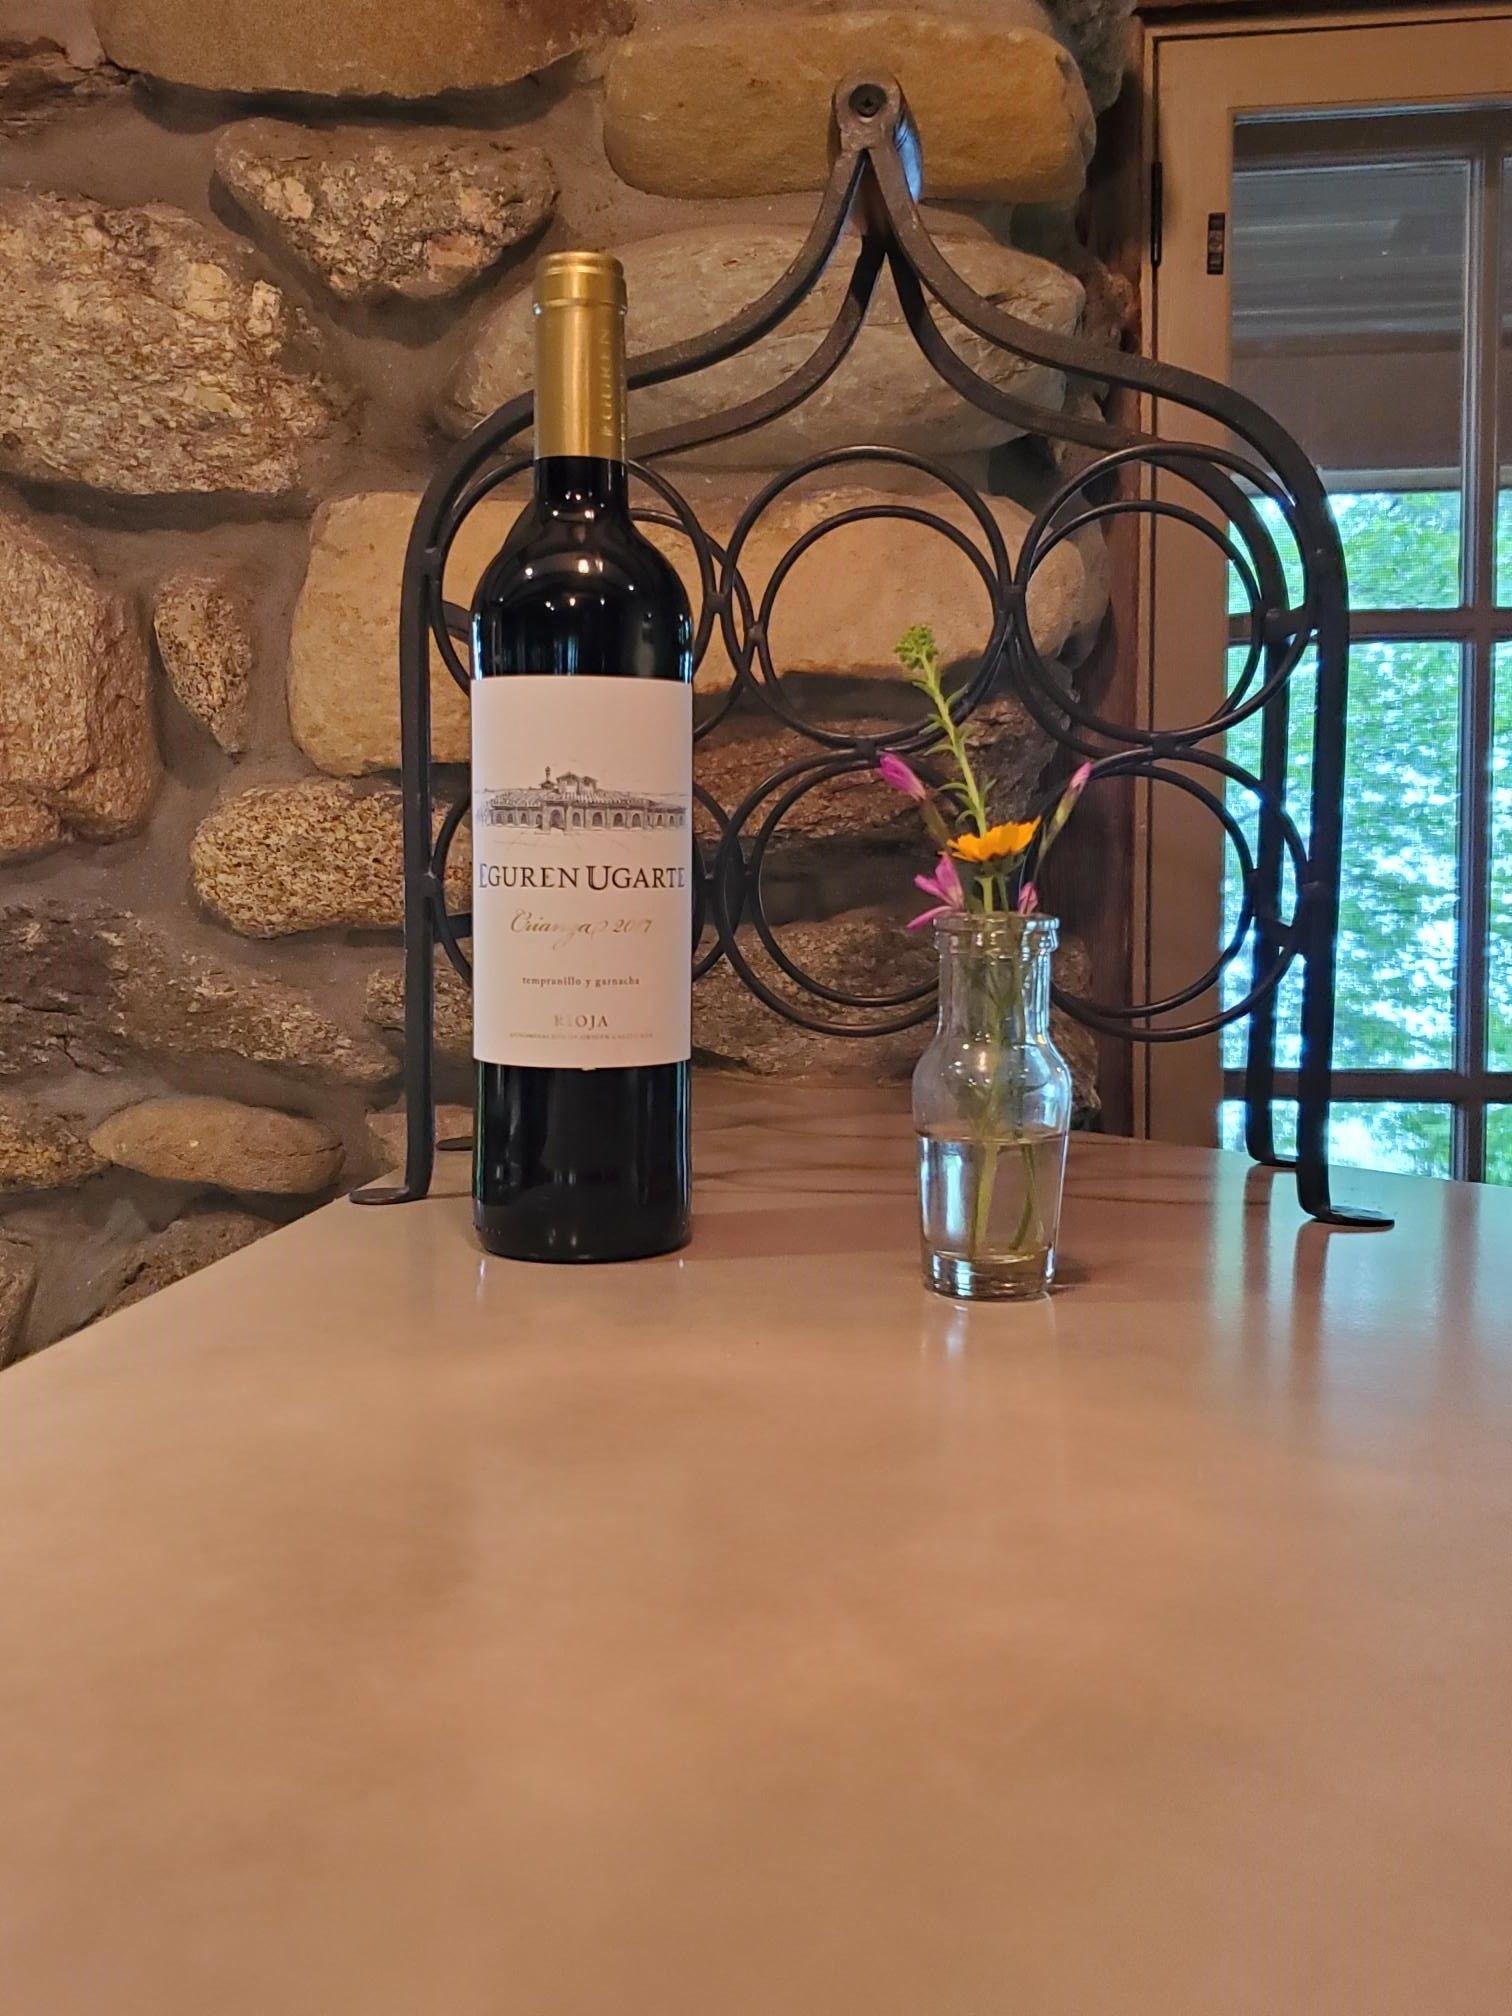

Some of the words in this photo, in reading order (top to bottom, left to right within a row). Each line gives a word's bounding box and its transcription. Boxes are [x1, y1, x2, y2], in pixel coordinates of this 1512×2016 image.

[479, 863, 580, 888] EGUREN
[586, 865, 686, 891] UGARTE
[613, 918, 652, 933] 207
[522, 976, 583, 988] tempranillo
[585, 979, 592, 988] y
[595, 977, 641, 988] garnacha
